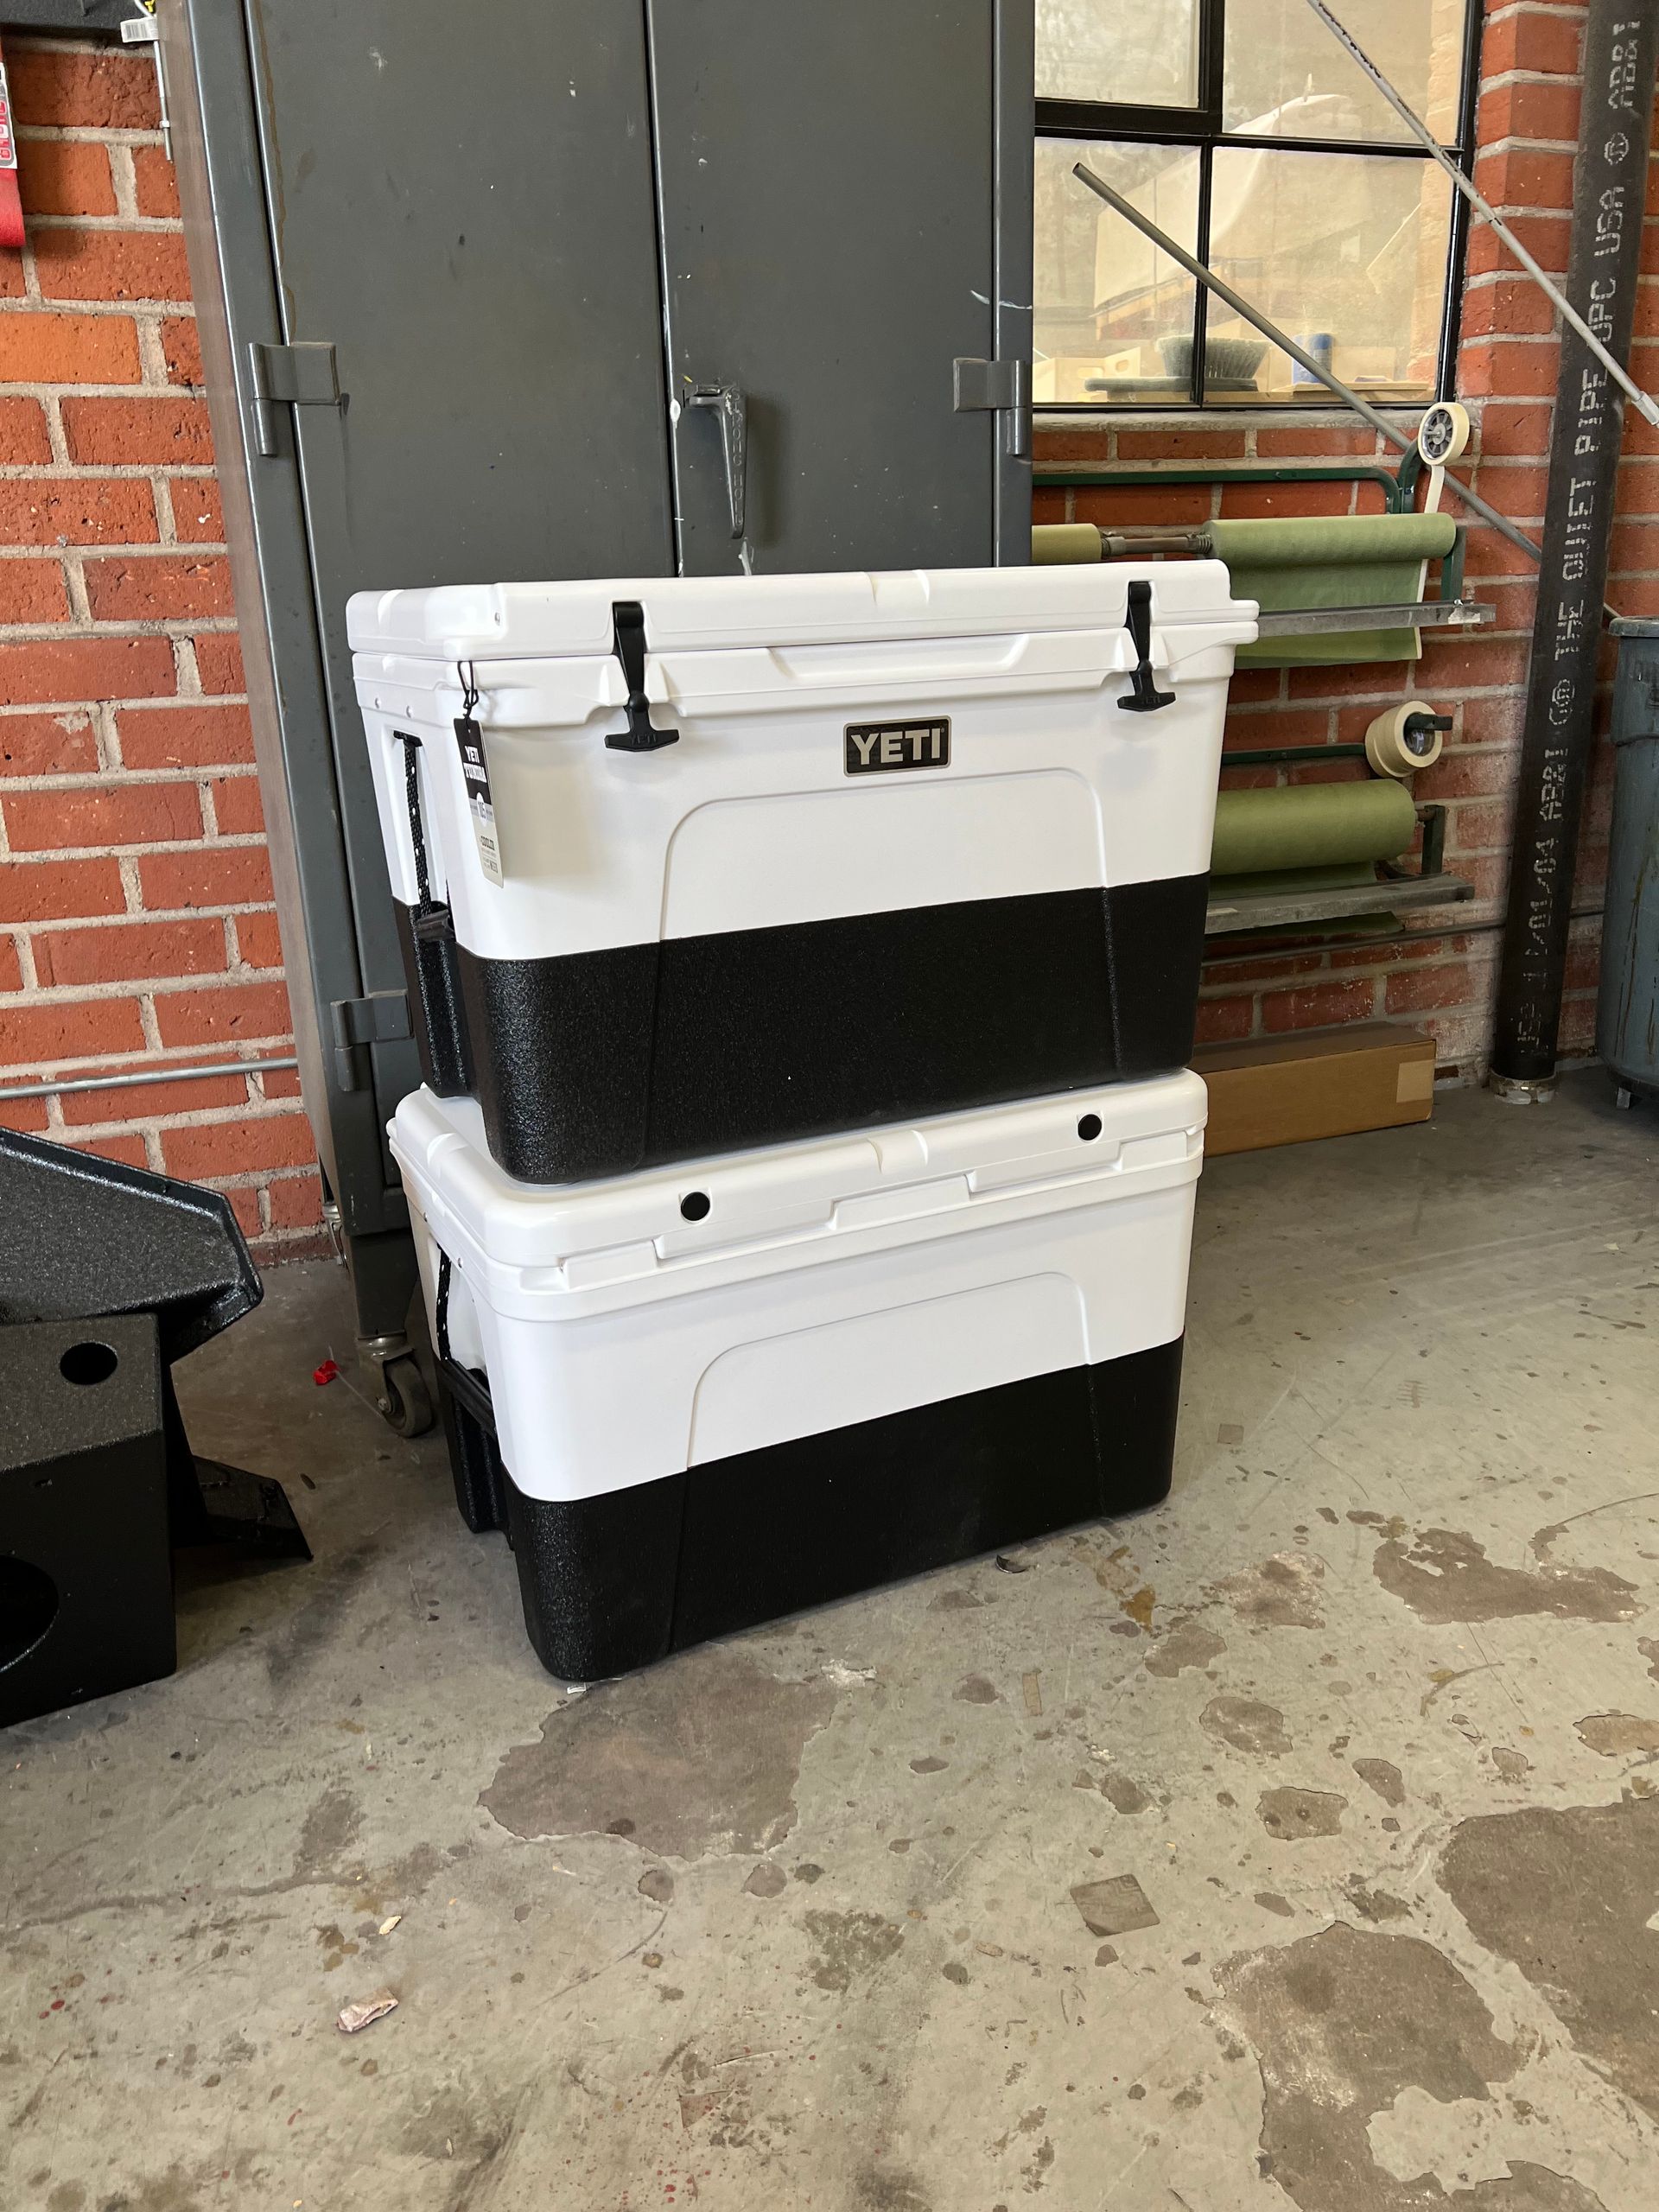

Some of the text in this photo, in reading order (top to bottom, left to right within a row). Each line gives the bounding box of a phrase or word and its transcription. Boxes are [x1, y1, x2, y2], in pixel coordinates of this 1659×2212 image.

[1593, 186, 1625, 257] USA
[1586, 277, 1617, 345] UPC
[1573, 367, 1608, 456] PIPE
[729, 387, 745, 526] STRONG HOLD
[1561, 478, 1597, 582] QUIET
[1554, 599, 1585, 661] THE
[464, 746, 480, 764] YETI
[630, 731, 657, 747] YETI
[850, 727, 942, 766] YETI
